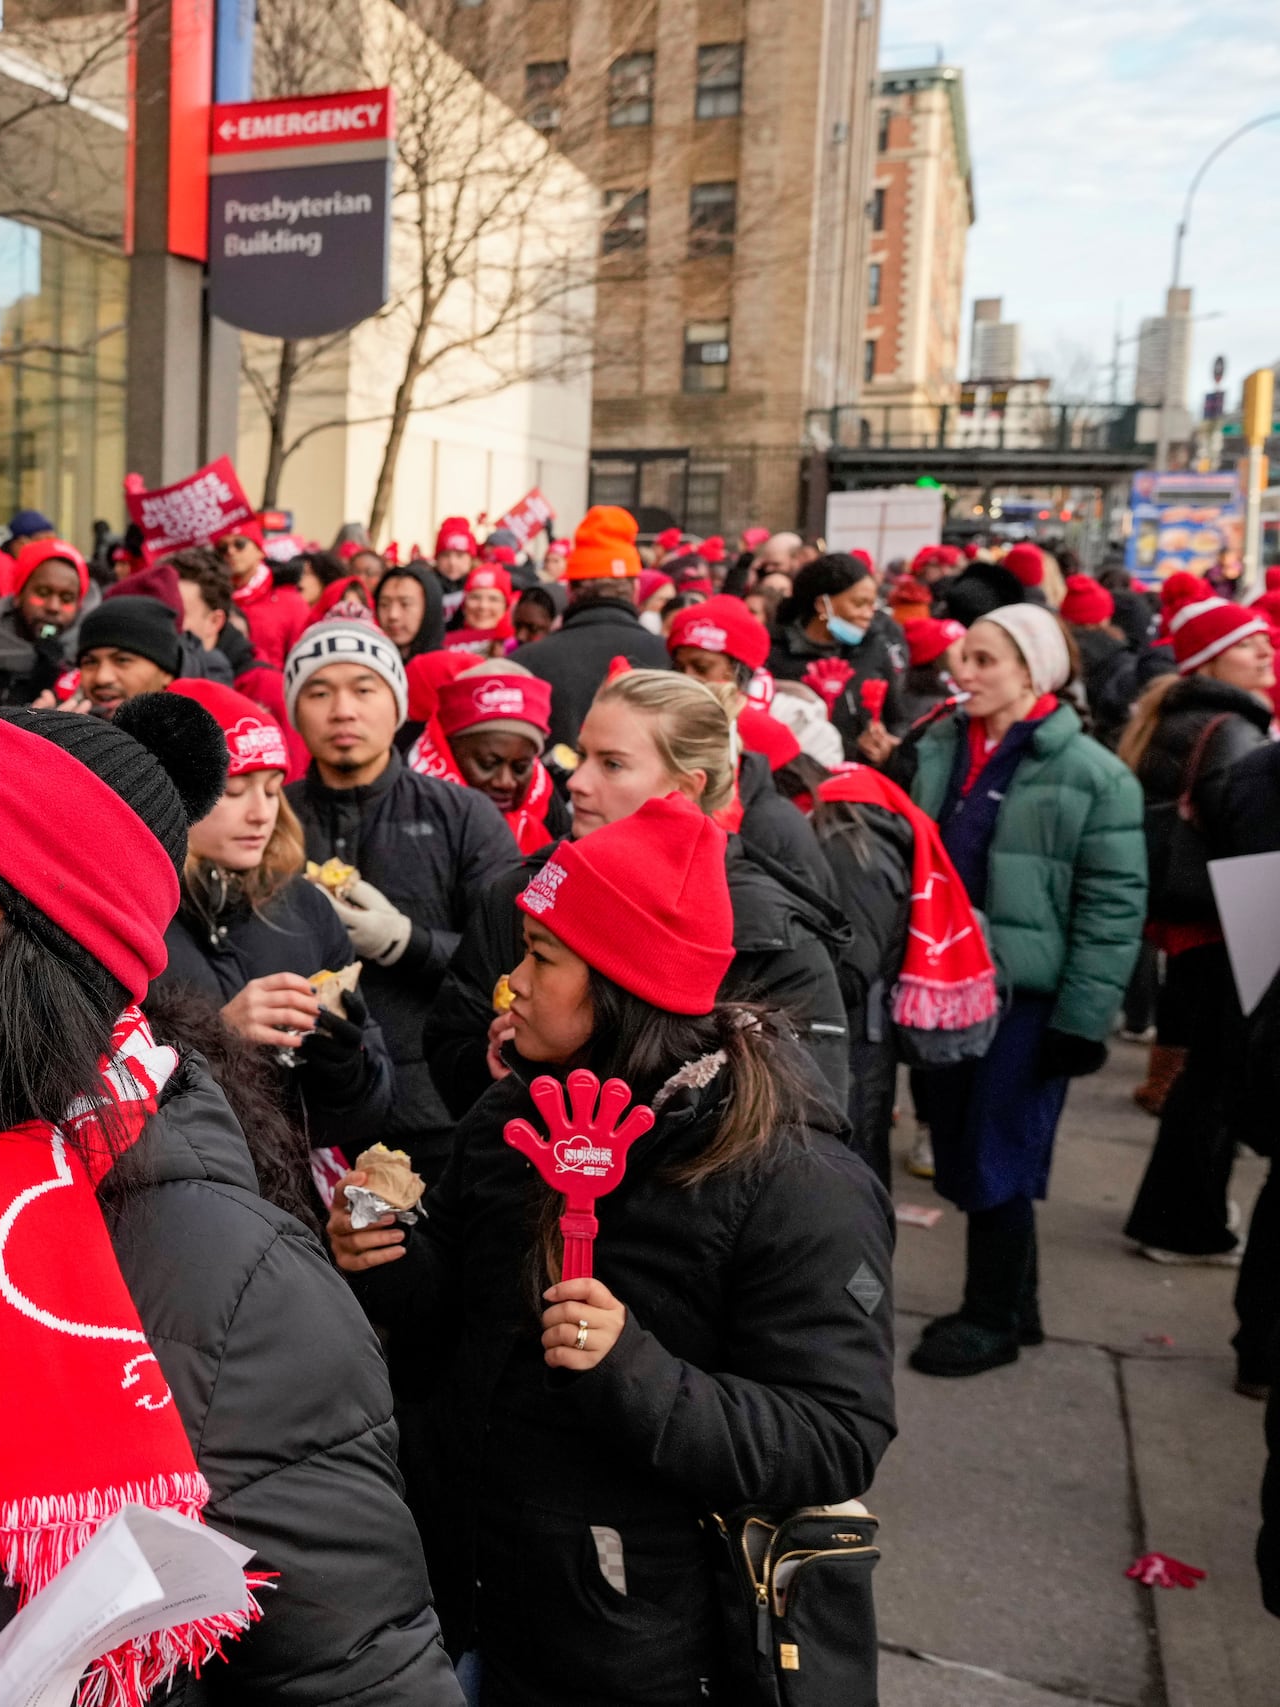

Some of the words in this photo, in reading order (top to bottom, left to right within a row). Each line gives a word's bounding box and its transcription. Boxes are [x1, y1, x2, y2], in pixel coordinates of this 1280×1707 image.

[238, 103, 384, 140] EMERGENCY
[224, 191, 372, 224] Presbyterian
[224, 230, 323, 257] Building
[142, 472, 222, 513] NURSES
[142, 483, 233, 529] DESERVE
[164, 506, 223, 538] GOOD
[286, 634, 403, 686] NDO
[564, 1148, 613, 1161] NURSES
